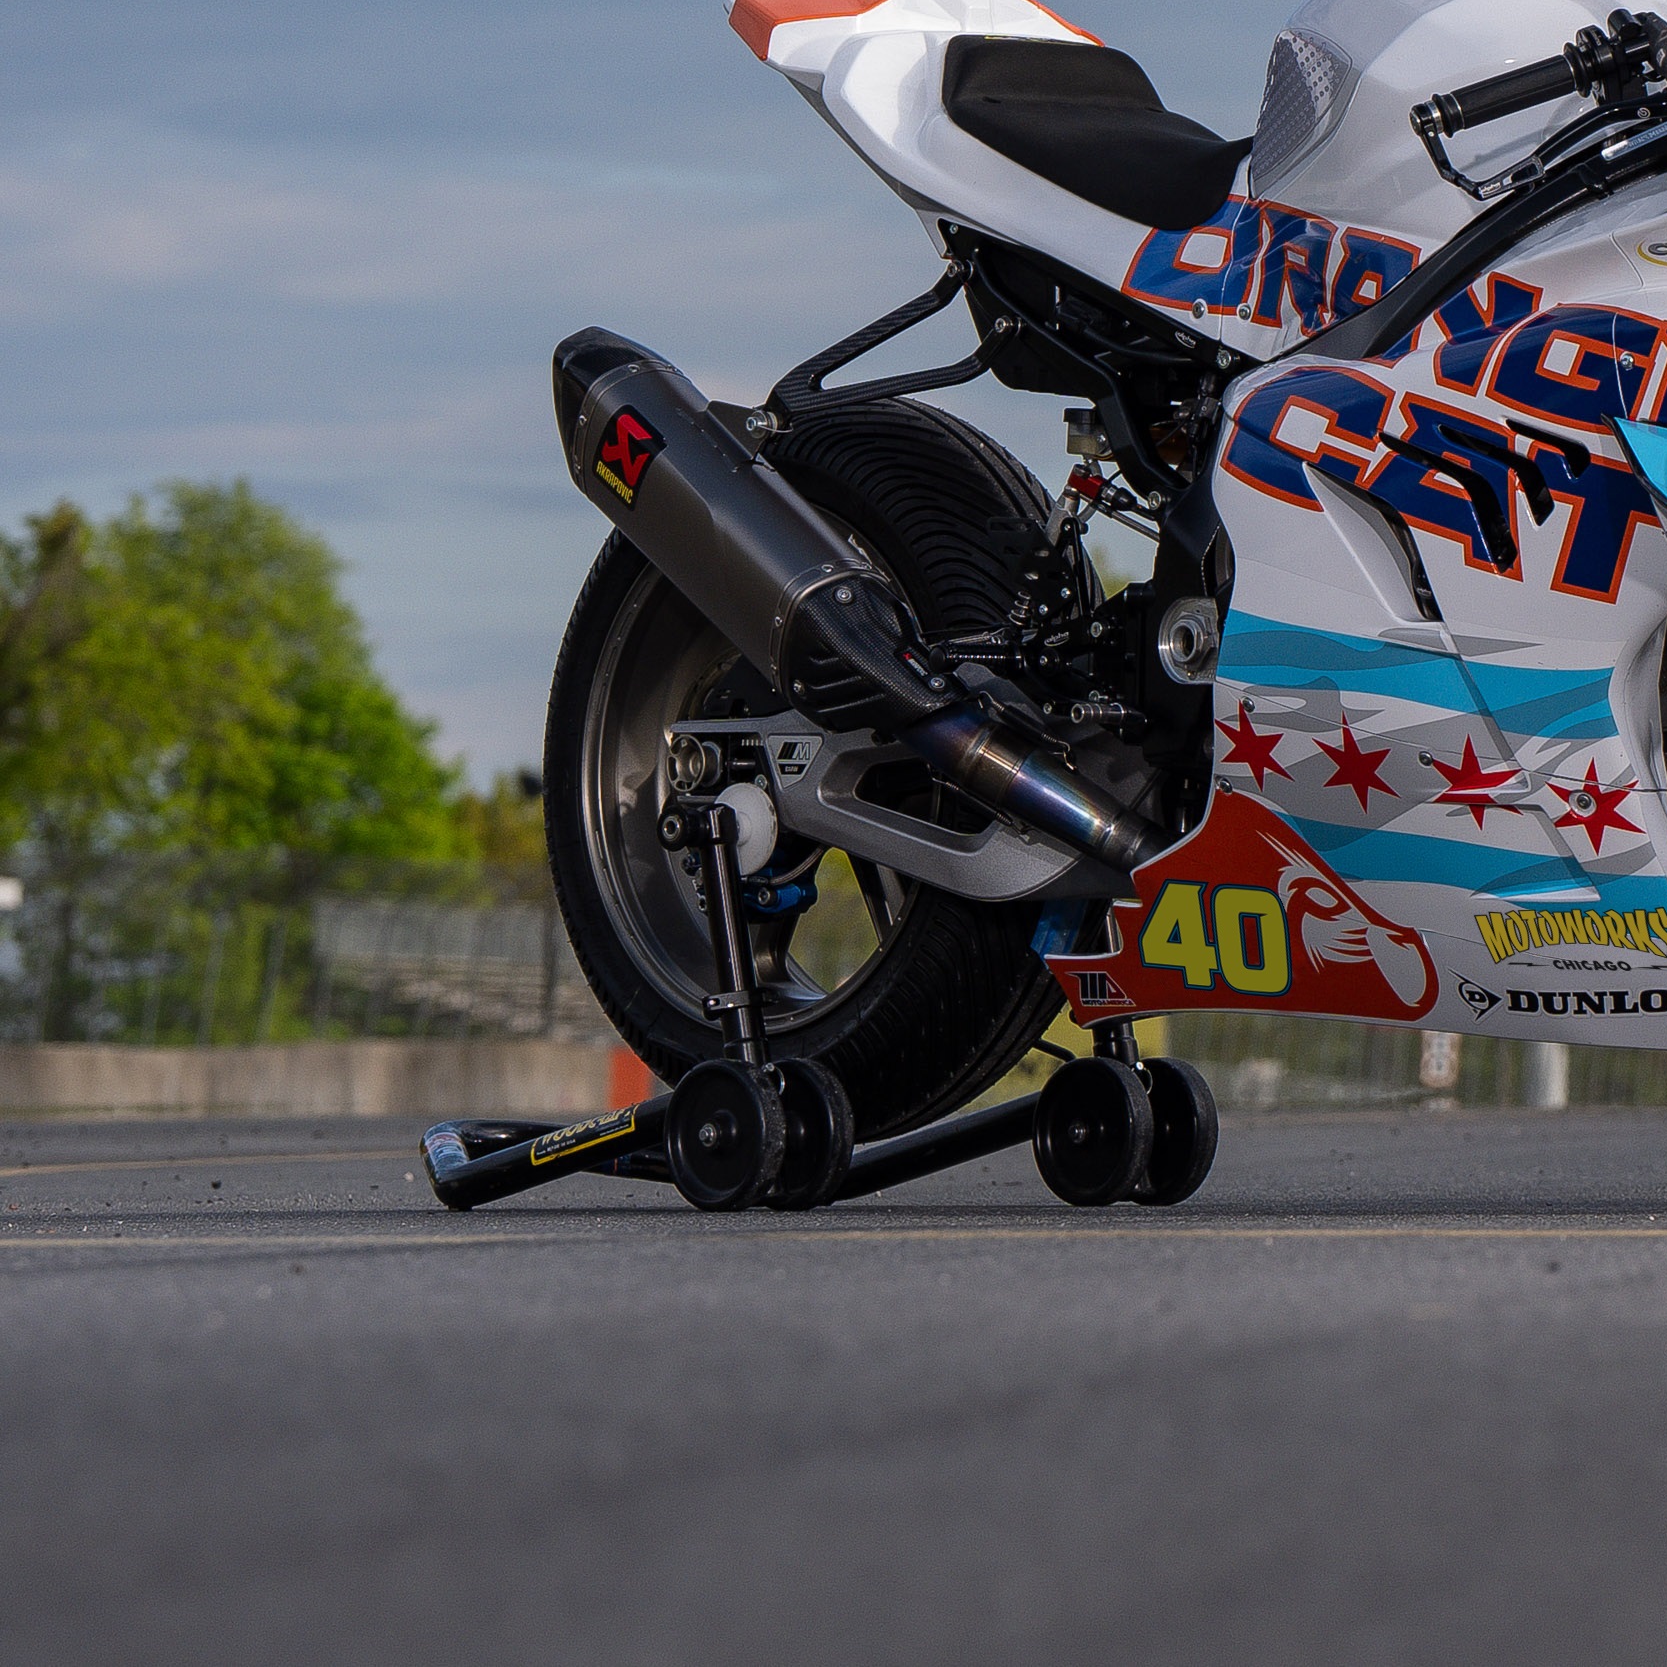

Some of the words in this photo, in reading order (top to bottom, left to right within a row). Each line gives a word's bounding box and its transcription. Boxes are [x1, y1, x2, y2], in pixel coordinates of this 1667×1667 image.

[1219, 365, 1663, 605] CAT
[1141, 879, 1291, 996] 40
[1552, 960, 1633, 972] CHICAGO
